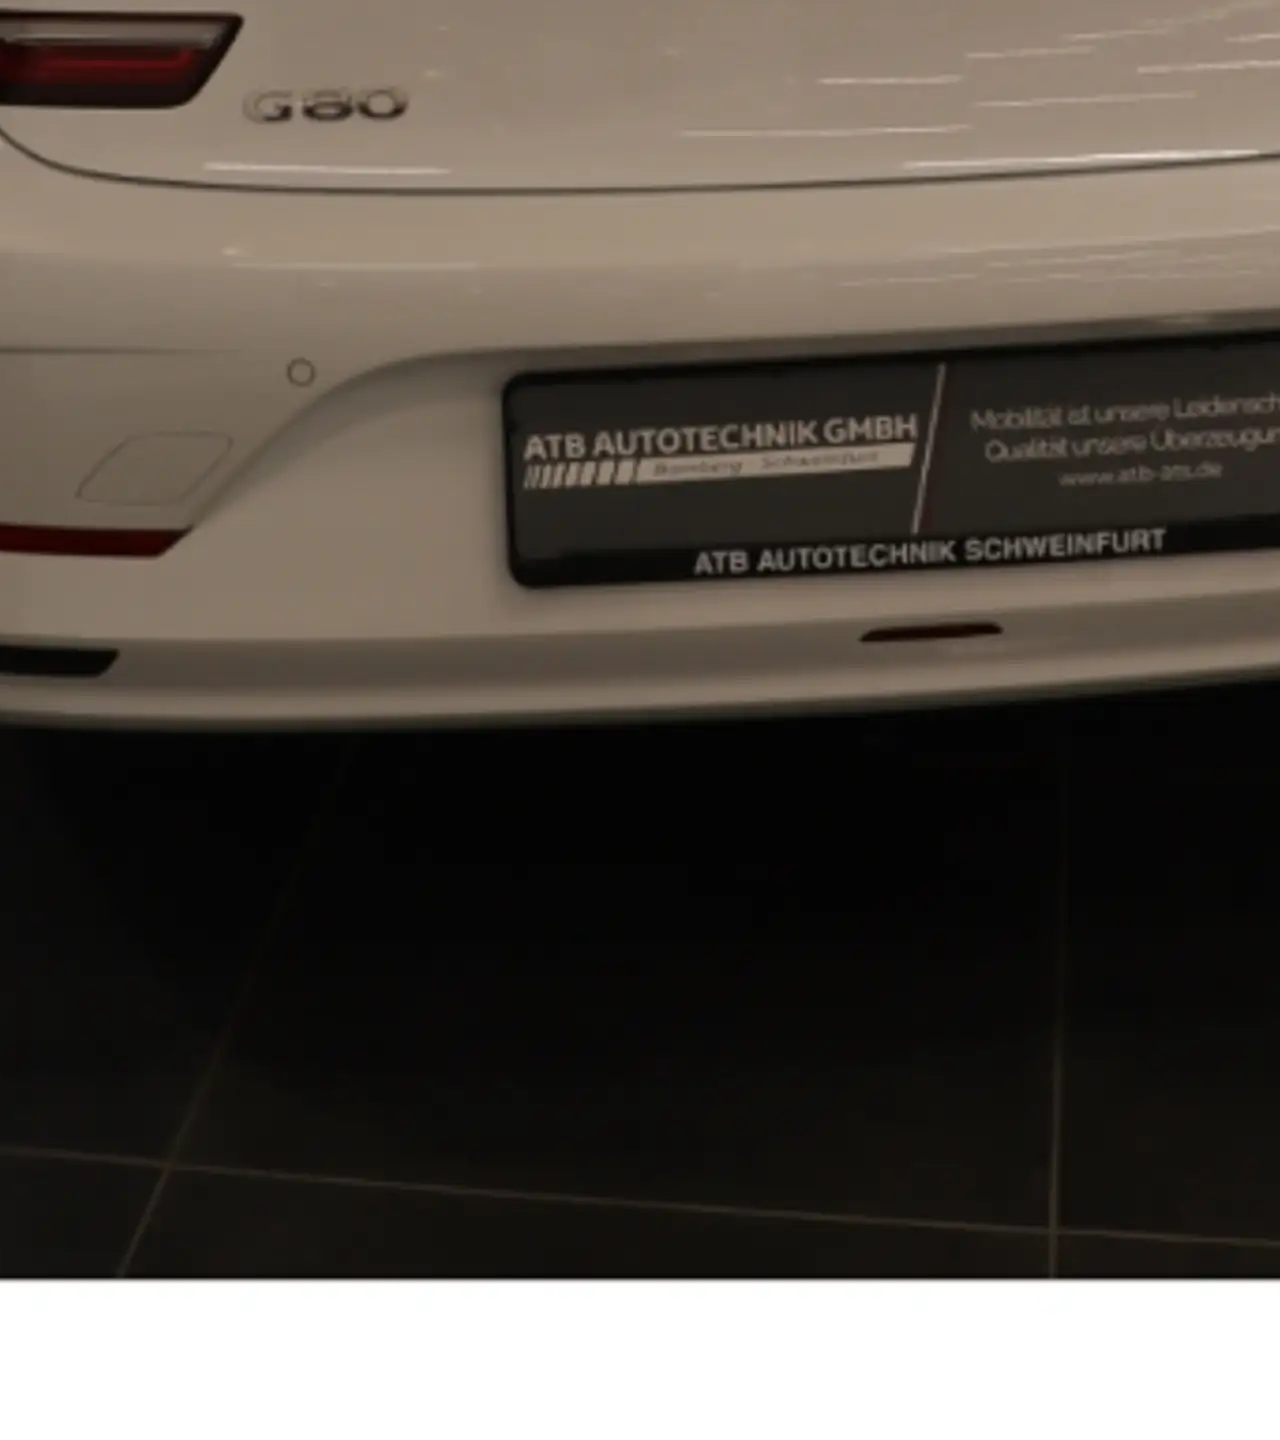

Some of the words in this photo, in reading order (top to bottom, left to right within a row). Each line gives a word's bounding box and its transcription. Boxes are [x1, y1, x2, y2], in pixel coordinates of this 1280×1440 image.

[243, 89, 410, 125] G80
[524, 433, 585, 460] ATB
[592, 420, 818, 457] AUTOTECHNIK
[823, 414, 918, 444] GMBH
[694, 550, 749, 576] ATB
[757, 540, 957, 573] AUTOTECHNIK
[964, 528, 1167, 561] SCHWEINFURT
